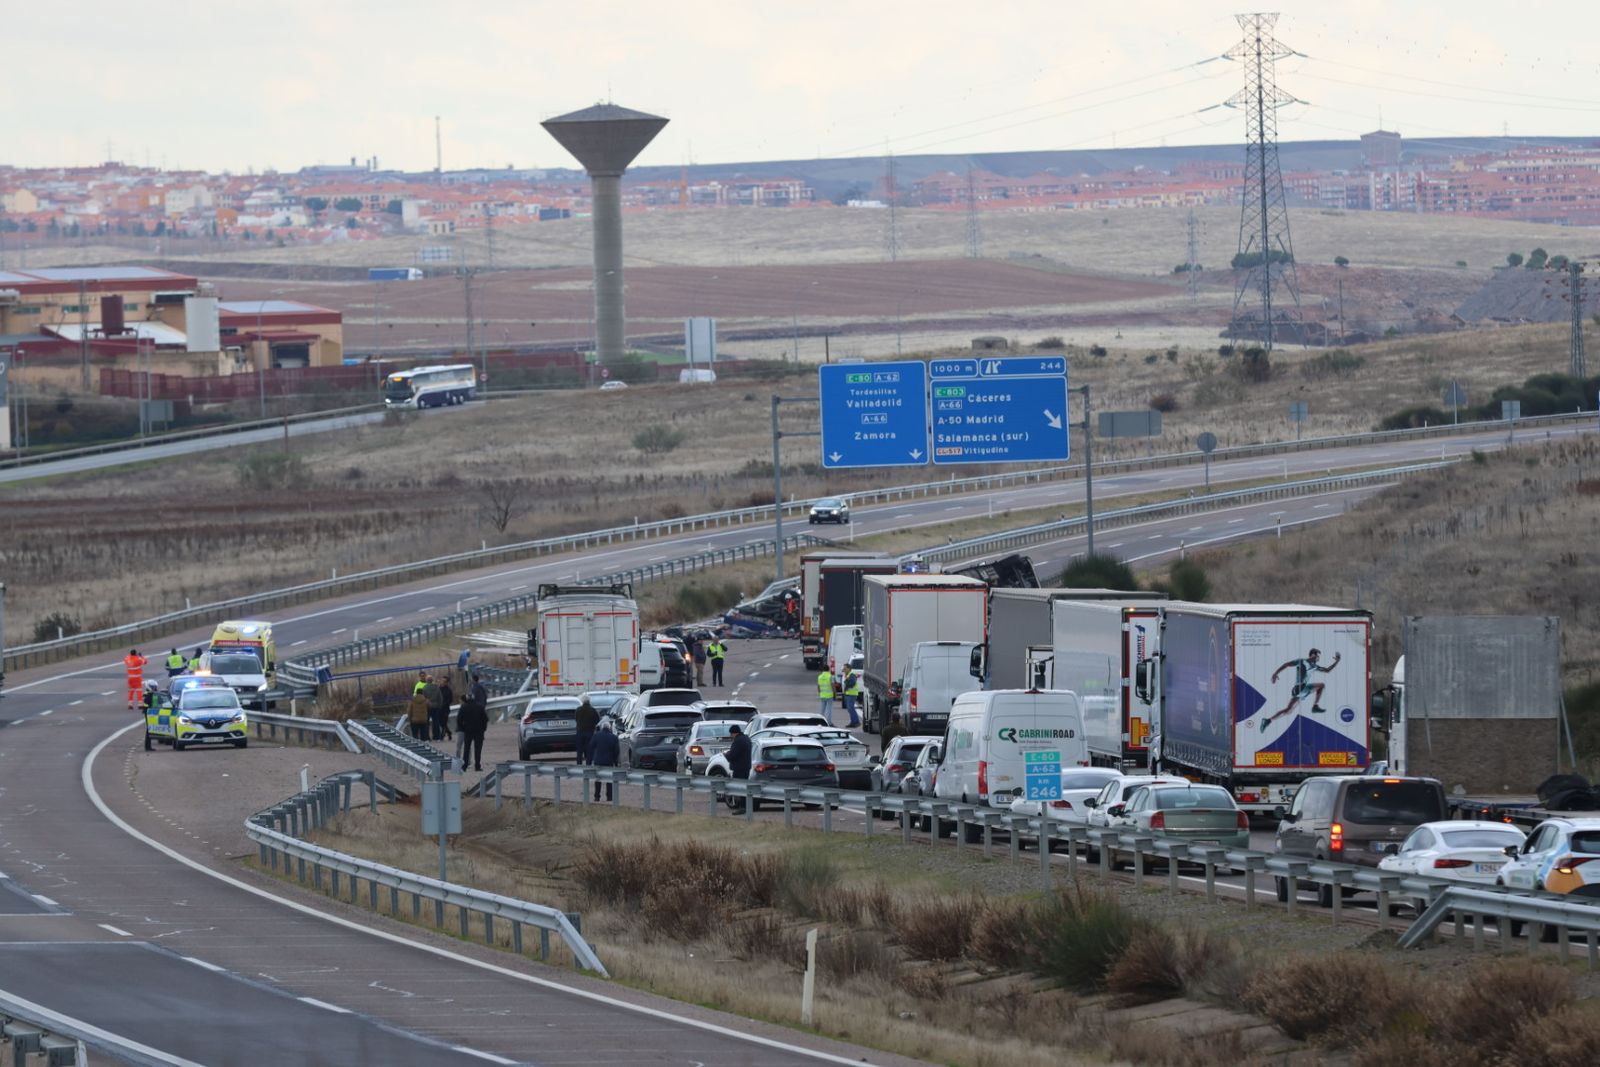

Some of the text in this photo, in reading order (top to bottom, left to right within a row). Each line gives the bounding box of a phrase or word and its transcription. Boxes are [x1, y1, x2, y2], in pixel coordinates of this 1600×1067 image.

[934, 365, 960, 373] 1000
[1040, 362, 1061, 370] 244
[848, 374, 870, 382] E-80
[876, 373, 898, 381] A-62
[850, 388, 897, 396] Tordesillas
[846, 398, 902, 408] Valladolid
[940, 401, 961, 409] A-66
[863, 415, 886, 423] A-66
[938, 415, 1004, 425] A-50 Madrid
[854, 431, 896, 440] Zamora
[938, 431, 1029, 443] Salamanca (sur)
[1031, 753, 1055, 761] E-80
[1032, 765, 1056, 773] A-62
[1031, 786, 1058, 798] 246
